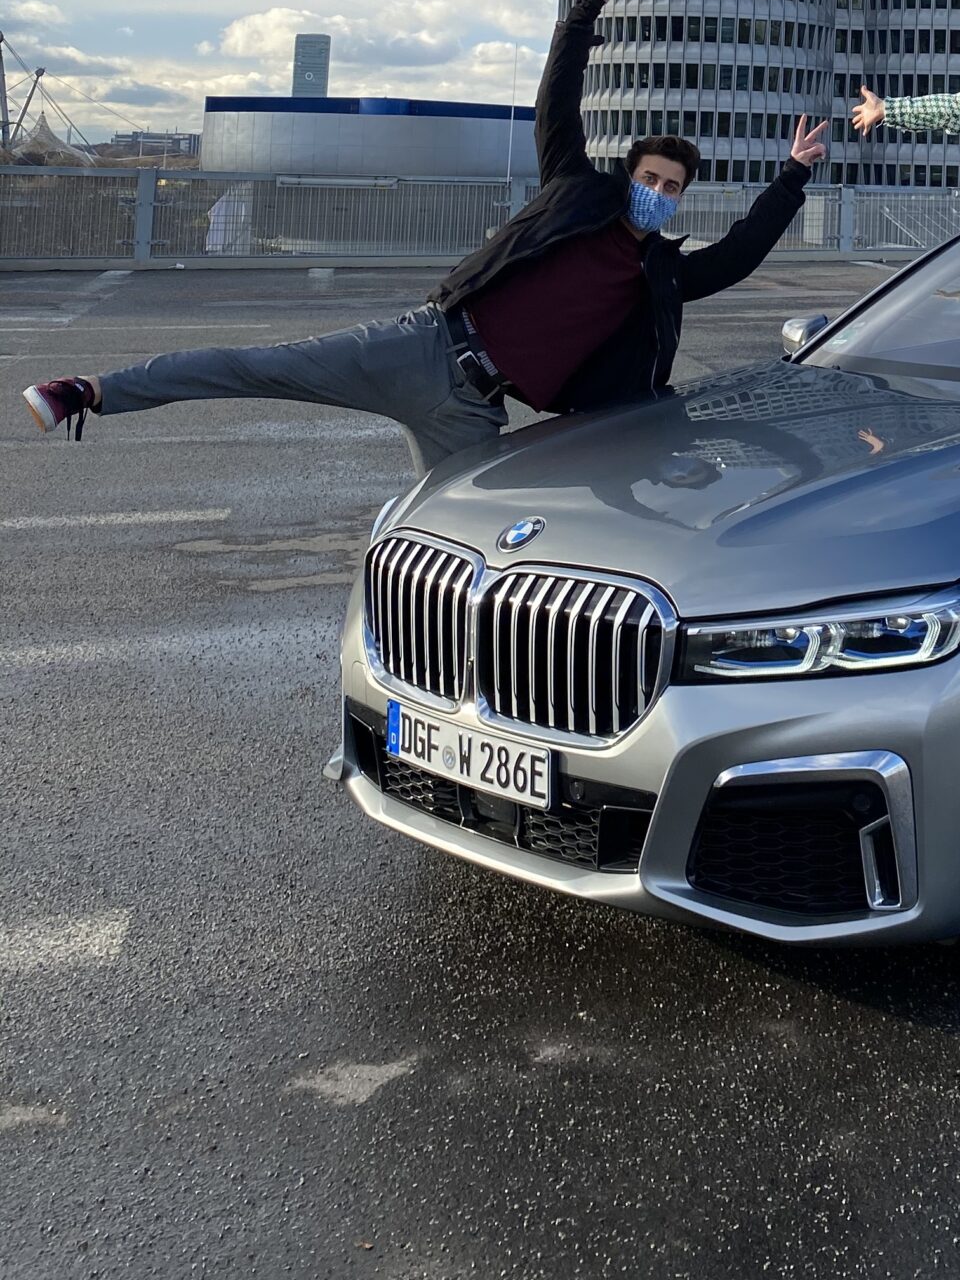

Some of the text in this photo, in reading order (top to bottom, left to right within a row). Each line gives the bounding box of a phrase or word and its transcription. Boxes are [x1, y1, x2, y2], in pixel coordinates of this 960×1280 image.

[391, 732, 397, 745] D
[401, 712, 546, 799] DGF W 286E
